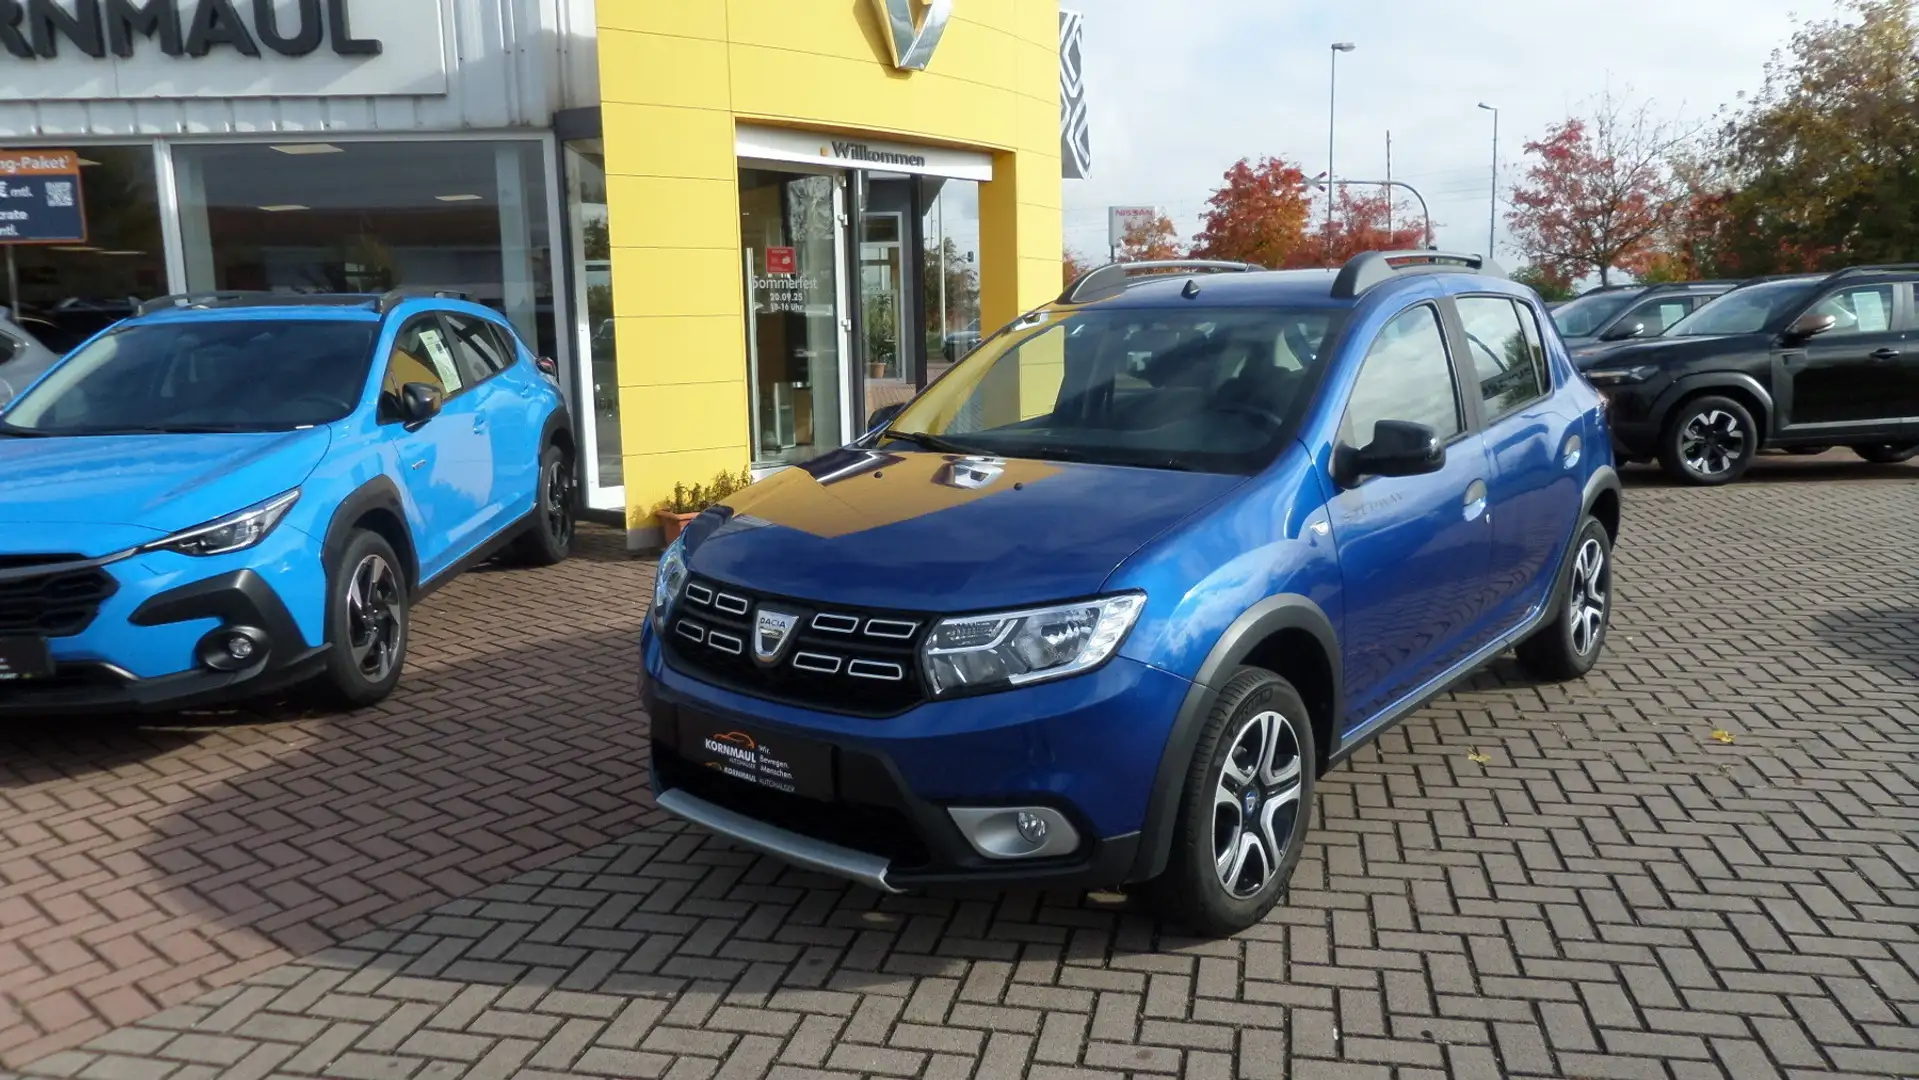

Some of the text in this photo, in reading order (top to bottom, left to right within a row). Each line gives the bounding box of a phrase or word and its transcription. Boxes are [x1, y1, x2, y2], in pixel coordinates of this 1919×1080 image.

[831, 140, 926, 167] Willkommen
[1115, 209, 1153, 217] NISSAN
[752, 275, 818, 289] Sommerfest
[769, 292, 803, 302] 20.09.25
[790, 302, 804, 312] Uhr
[760, 617, 786, 628] DACIA
[704, 738, 757, 764] KORNMAUL
